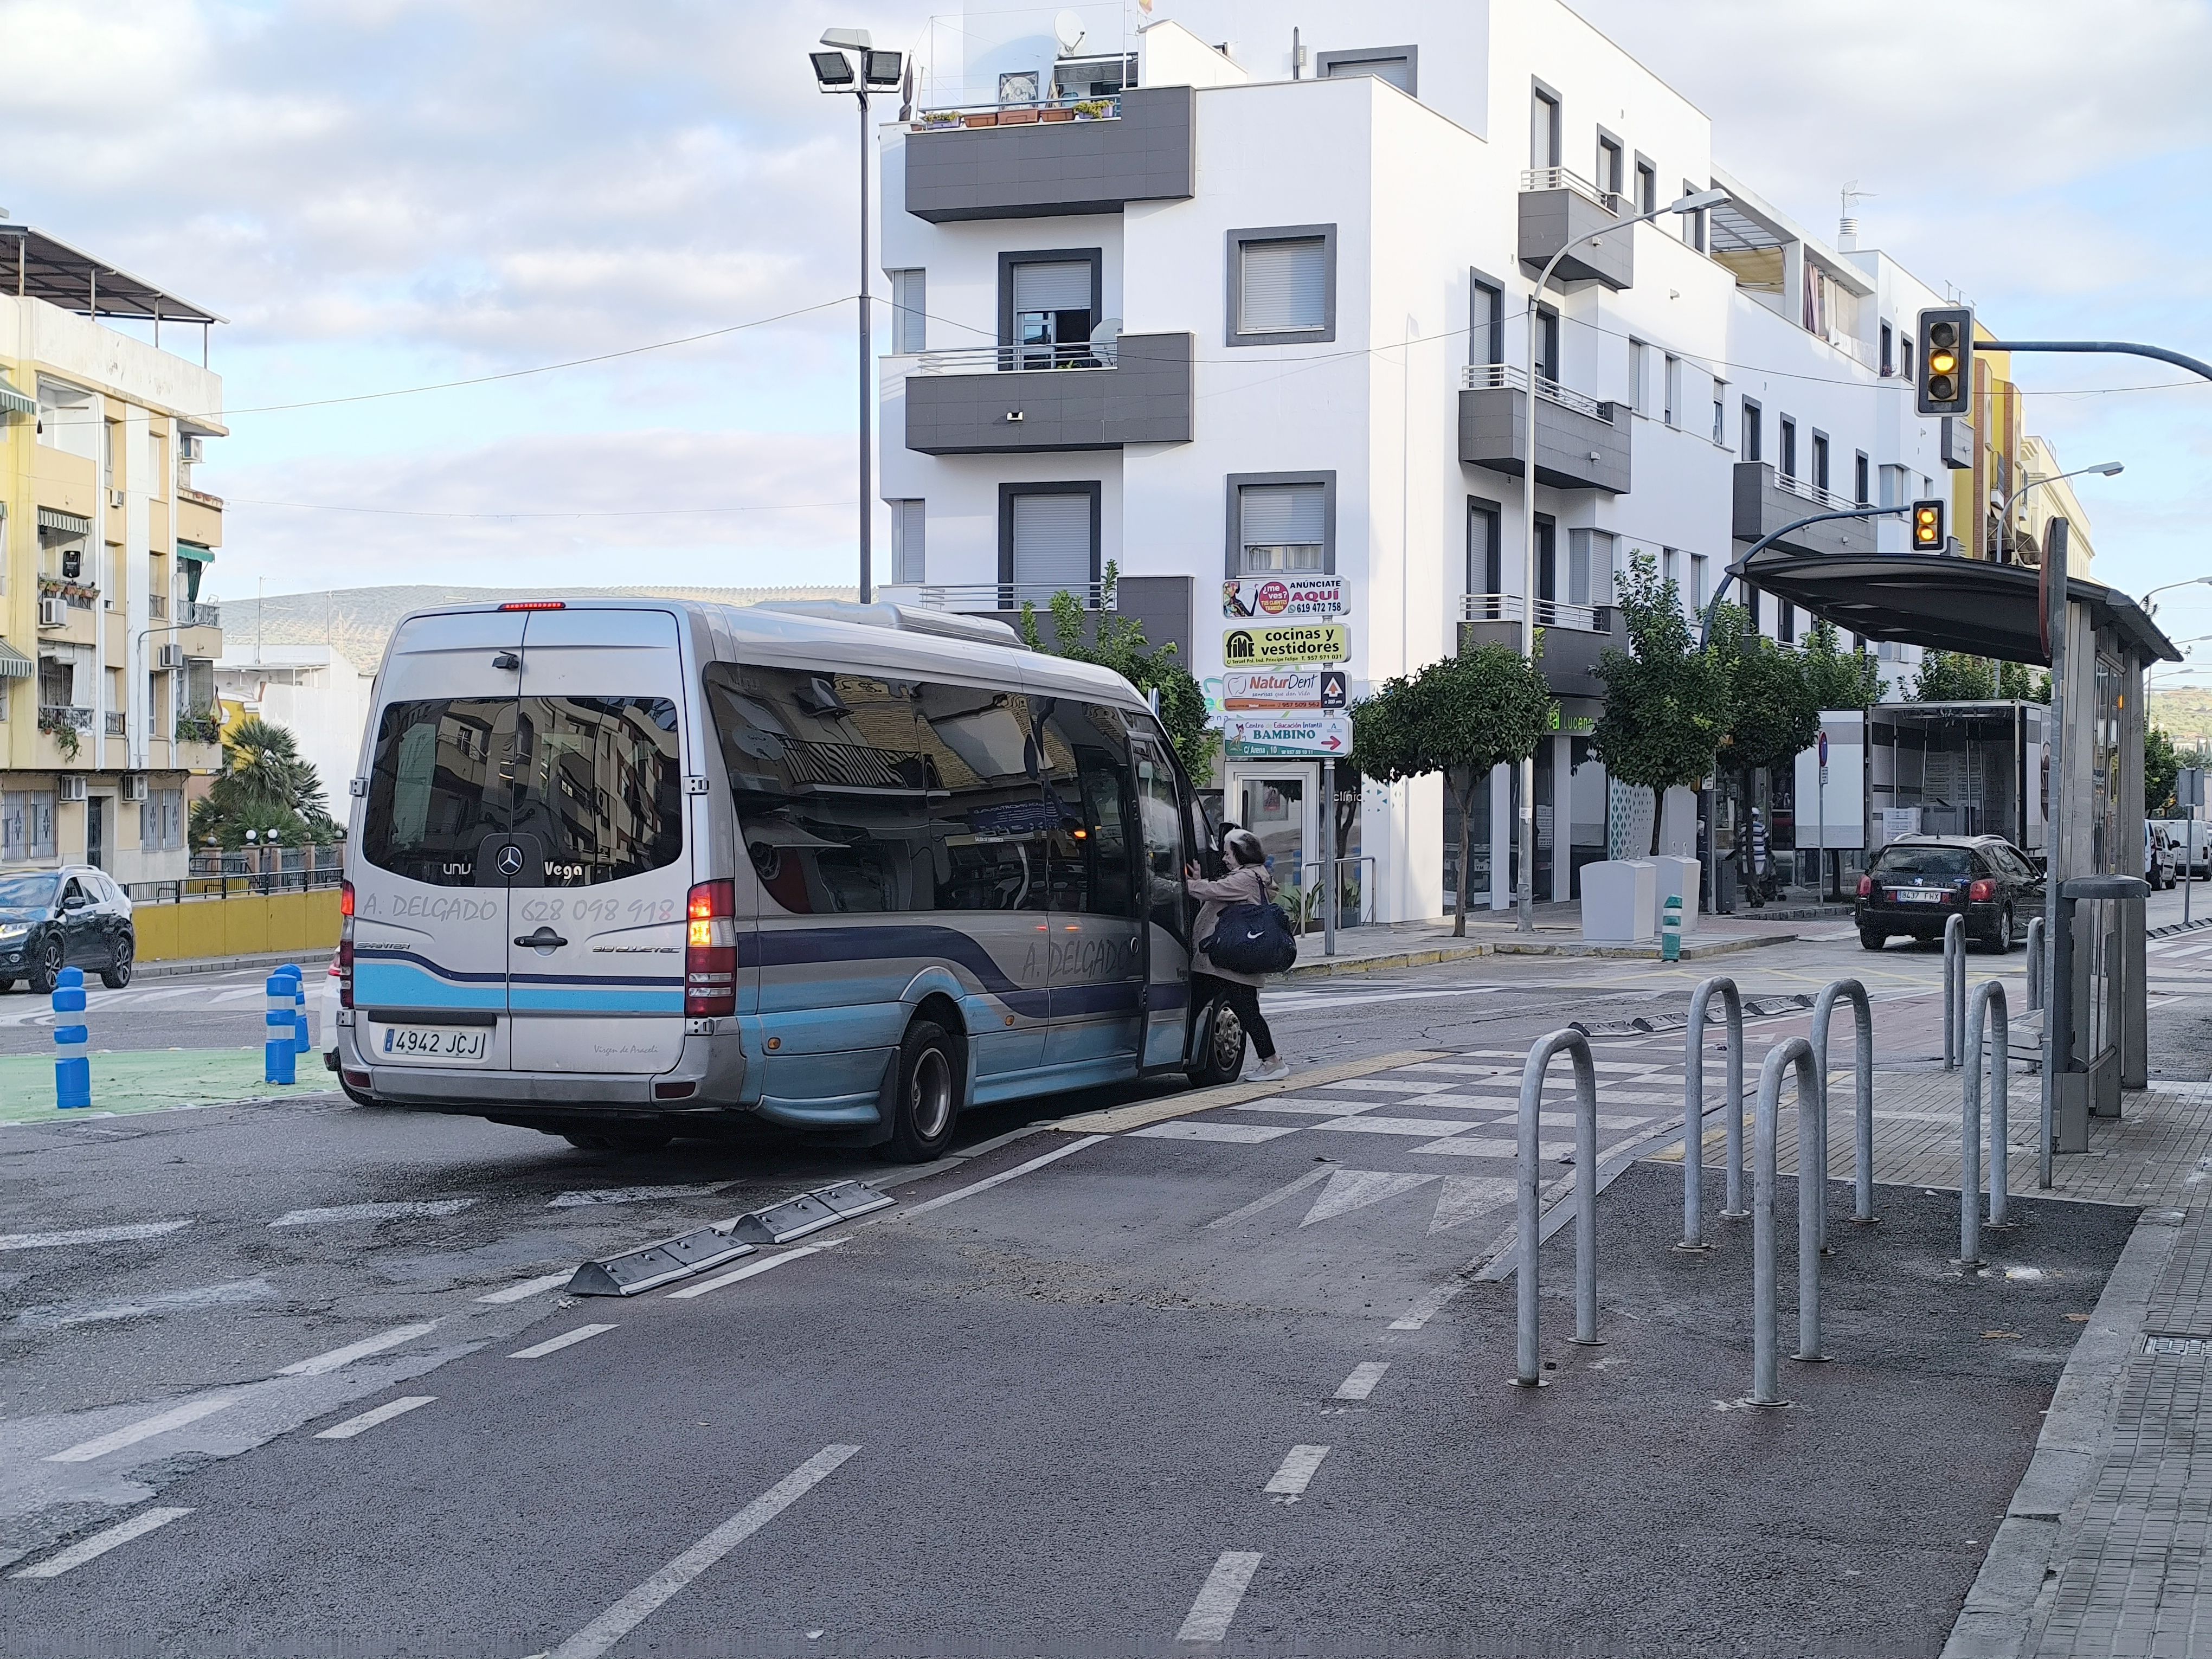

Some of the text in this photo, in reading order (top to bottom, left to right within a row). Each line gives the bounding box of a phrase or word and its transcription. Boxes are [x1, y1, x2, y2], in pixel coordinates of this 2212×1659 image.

[1262, 586, 1280, 594] ¿me
[1290, 580, 1341, 589] ANÚNCIATE
[1268, 591, 1288, 599] ves?
[1291, 588, 1340, 602] AQUÍ
[1297, 602, 1341, 613] 619 472 758
[1265, 628, 1334, 641] cocinas y
[1261, 641, 1339, 655] vestidores
[1250, 674, 1318, 689] NaturDent
[1253, 730, 1316, 740] BAMBINO
[544, 861, 582, 879] Vega
[363, 893, 497, 921] A. DELGADO
[522, 898, 674, 923] 628 098 918
[356, 941, 410, 949] SPRINTER
[1022, 942, 1040, 980] A.
[396, 1031, 478, 1054] 4942 JCJ
[594, 1044, 659, 1057] Virgen de Araceli
